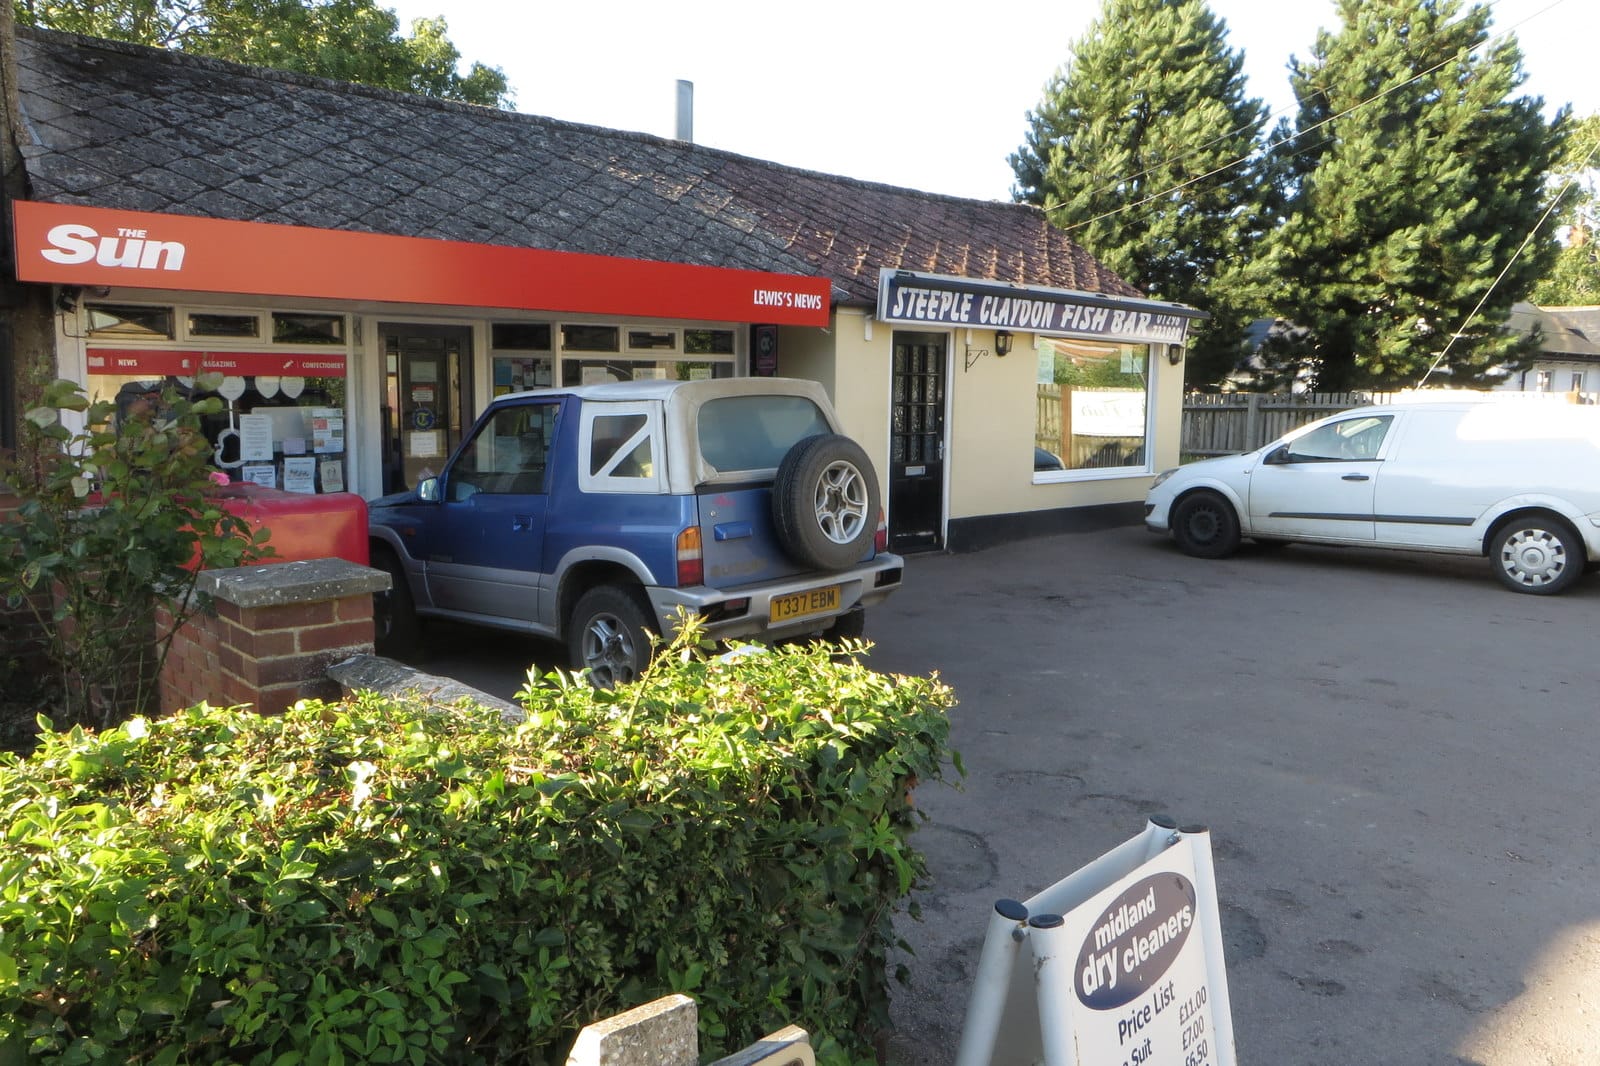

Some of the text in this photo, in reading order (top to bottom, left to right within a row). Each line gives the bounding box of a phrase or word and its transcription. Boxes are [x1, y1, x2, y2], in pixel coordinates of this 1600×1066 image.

[40, 223, 186, 271] Sun
[117, 227, 148, 239] THE
[753, 289, 822, 310] LEWIS'S NEWS
[892, 286, 1152, 337] STEEPLE CLAYDON FISH BAR
[118, 359, 138, 367] NEWS
[302, 362, 345, 370] CONFECTIONERY
[775, 589, 836, 617] T337 EBM
[1094, 887, 1156, 951] midland
[1082, 904, 1192, 997] dry cleaners
[1117, 980, 1176, 1046] Price List
[1179, 985, 1207, 1026] £11.00
[1131, 1037, 1153, 1066] Suit
[1182, 1015, 1205, 1052] £7.00
